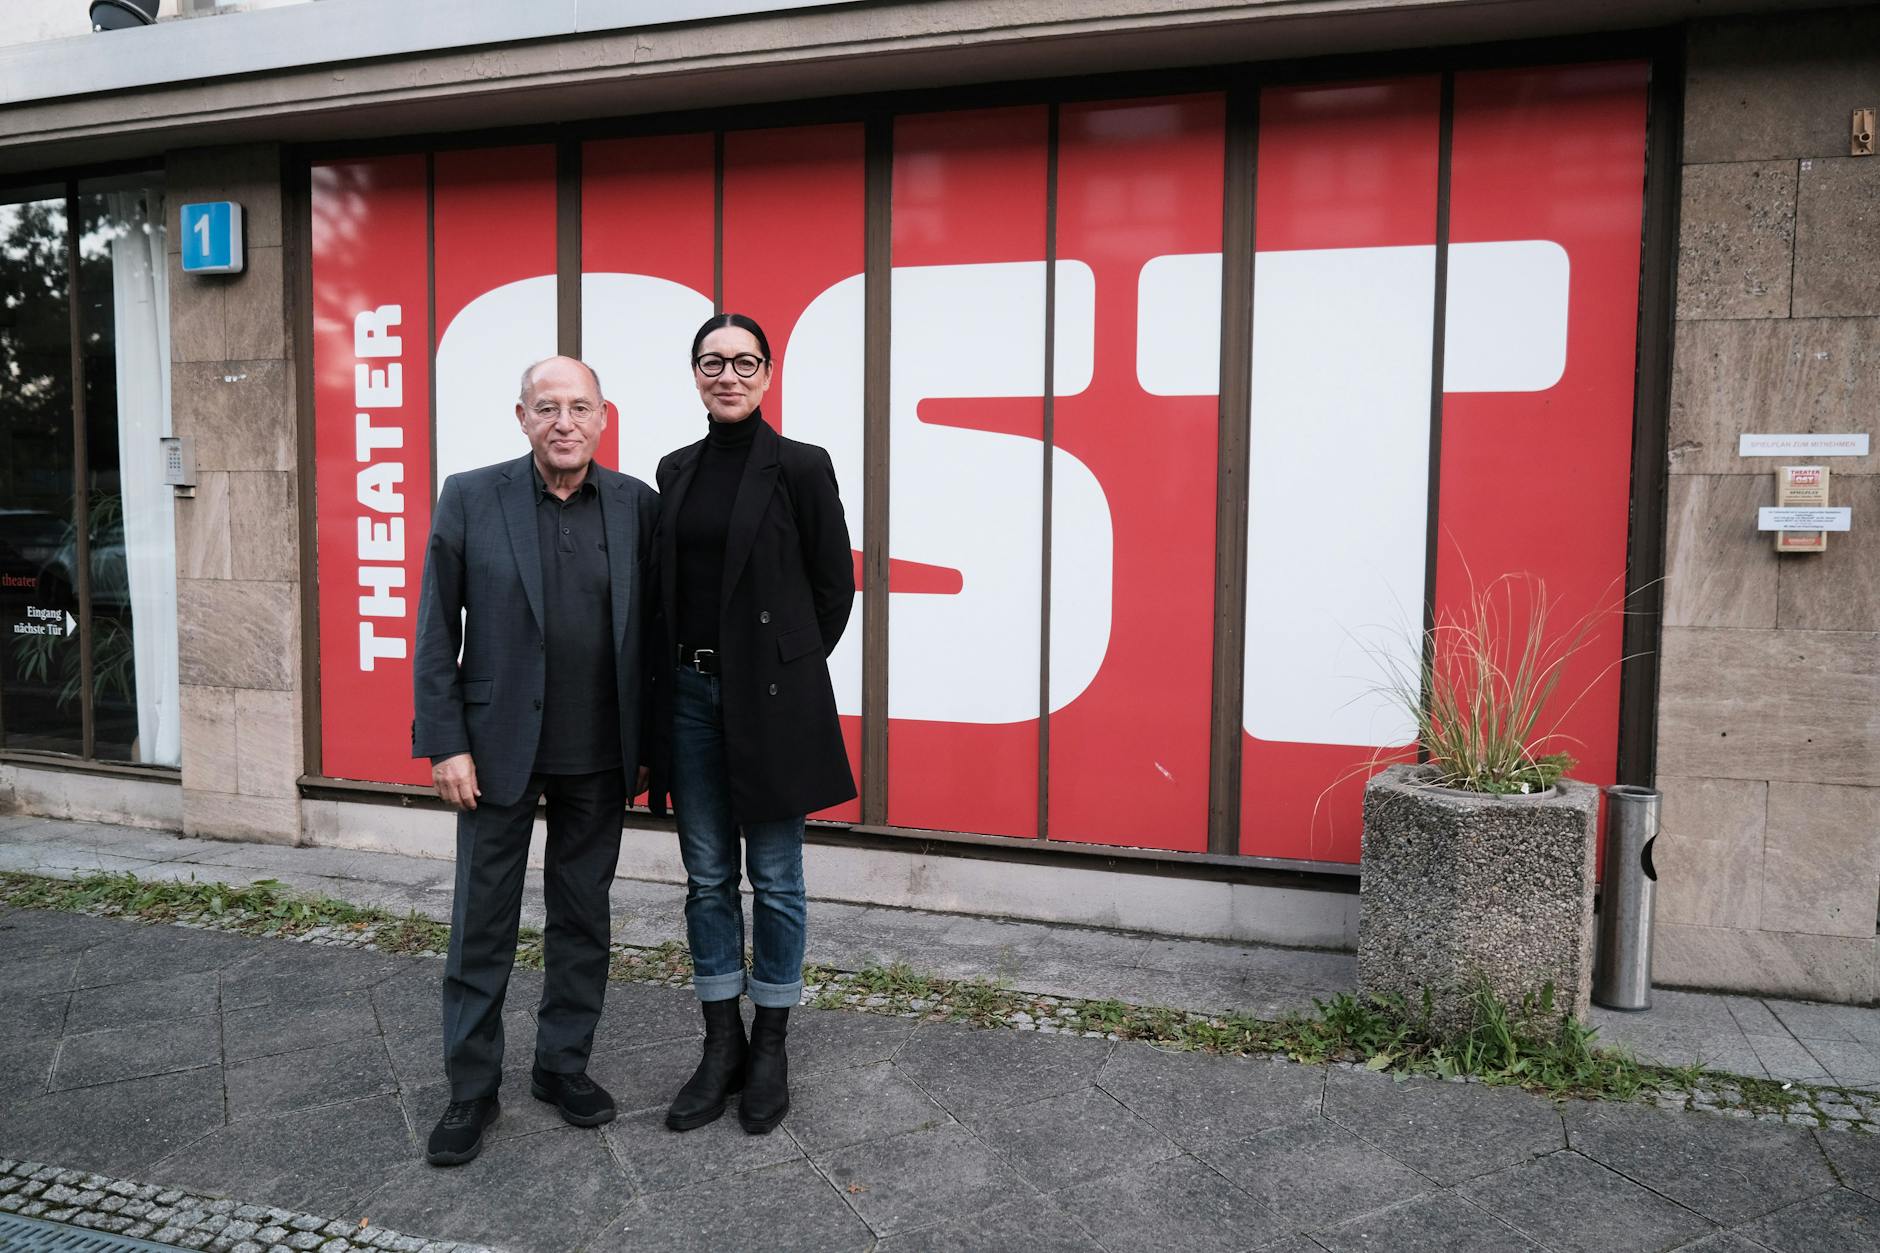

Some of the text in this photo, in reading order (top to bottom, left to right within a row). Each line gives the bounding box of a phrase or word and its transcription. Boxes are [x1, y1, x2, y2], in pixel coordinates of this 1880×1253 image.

[194, 213, 210, 257] 1
[354, 304, 407, 671] THEATER
[2, 573, 36, 587] theater
[27, 605, 62, 621] Eingang
[14, 622, 63, 636] nächste Tür
